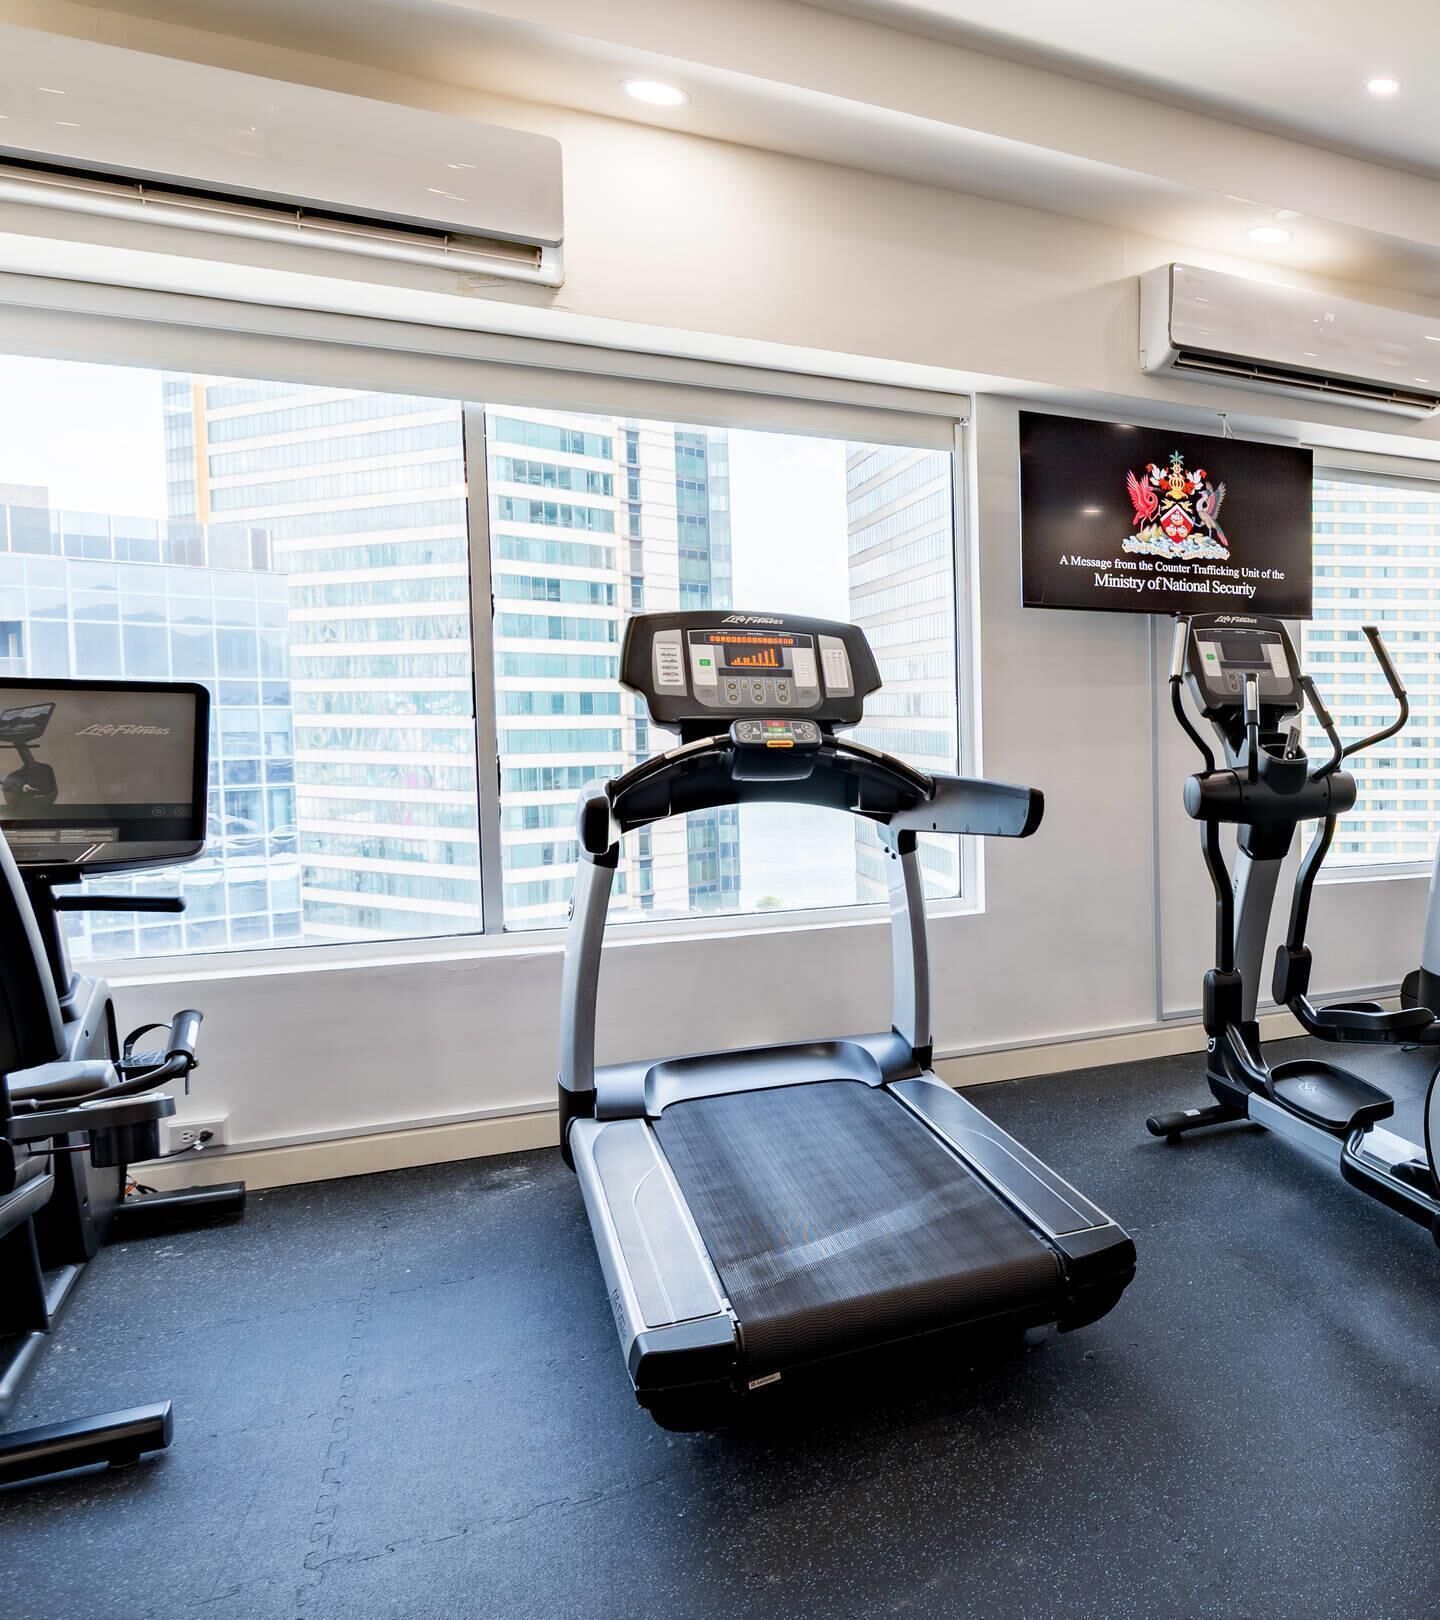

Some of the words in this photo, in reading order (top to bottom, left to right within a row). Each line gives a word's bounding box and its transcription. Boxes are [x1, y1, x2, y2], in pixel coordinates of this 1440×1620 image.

[1060, 555, 1069, 565] A
[1071, 555, 1112, 570] Message
[1114, 559, 1137, 570] from
[1139, 560, 1153, 571] the
[1155, 561, 1191, 573] Counter
[1192, 564, 1239, 578] Trafficking
[1241, 567, 1260, 578] Unit
[1261, 569, 1272, 579] of
[1272, 570, 1285, 580] the
[1094, 573, 1145, 592] Ministry
[1147, 577, 1161, 590] of
[1162, 577, 1210, 593] National
[1212, 580, 1256, 598] Security
